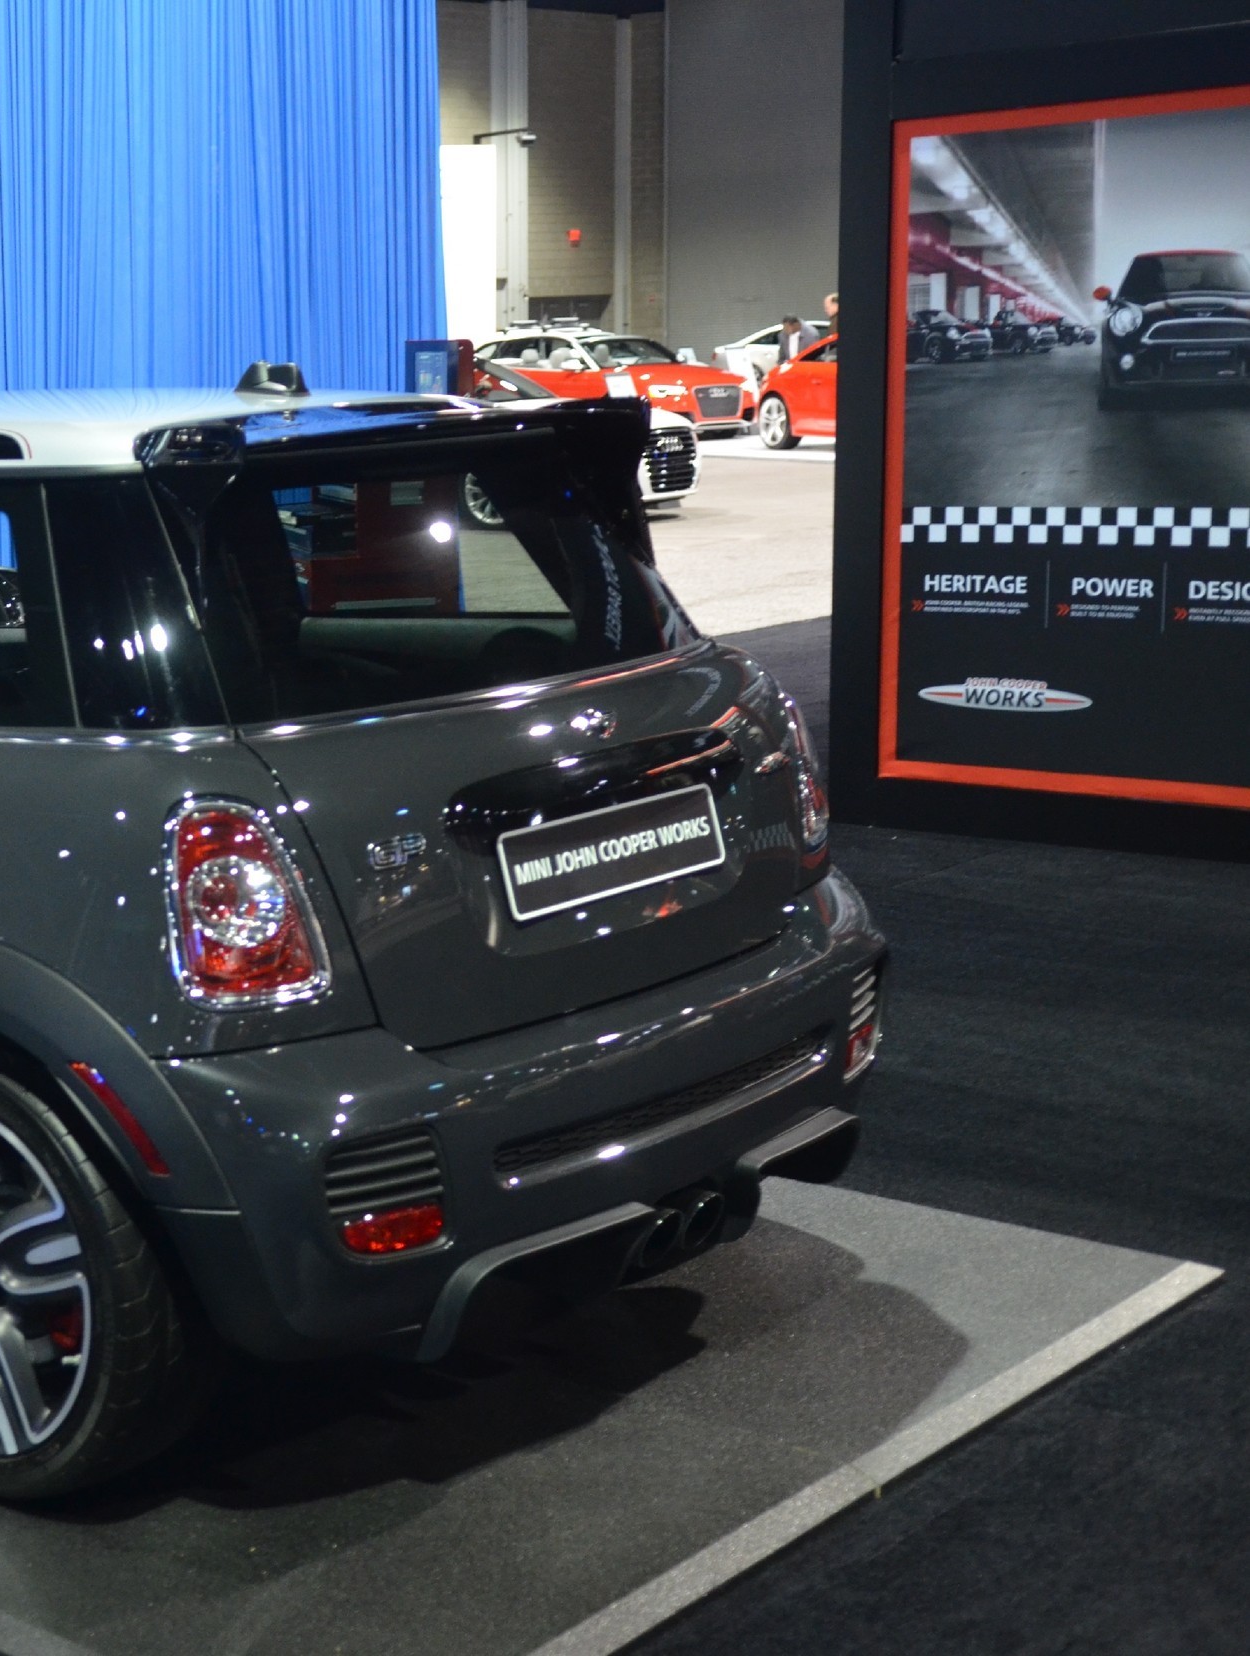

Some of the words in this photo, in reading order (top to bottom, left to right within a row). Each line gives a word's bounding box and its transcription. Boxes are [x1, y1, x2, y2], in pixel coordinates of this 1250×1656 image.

[924, 574, 1028, 594] HERITAGE
[1071, 577, 1154, 598] POWER
[965, 677, 998, 686] JOHN
[999, 678, 1047, 689] COOPER
[965, 688, 1045, 708] WORKS
[514, 856, 552, 885] MINI
[554, 844, 598, 876] JOHN
[599, 829, 658, 862] COOPER
[656, 816, 711, 846] WORKS
